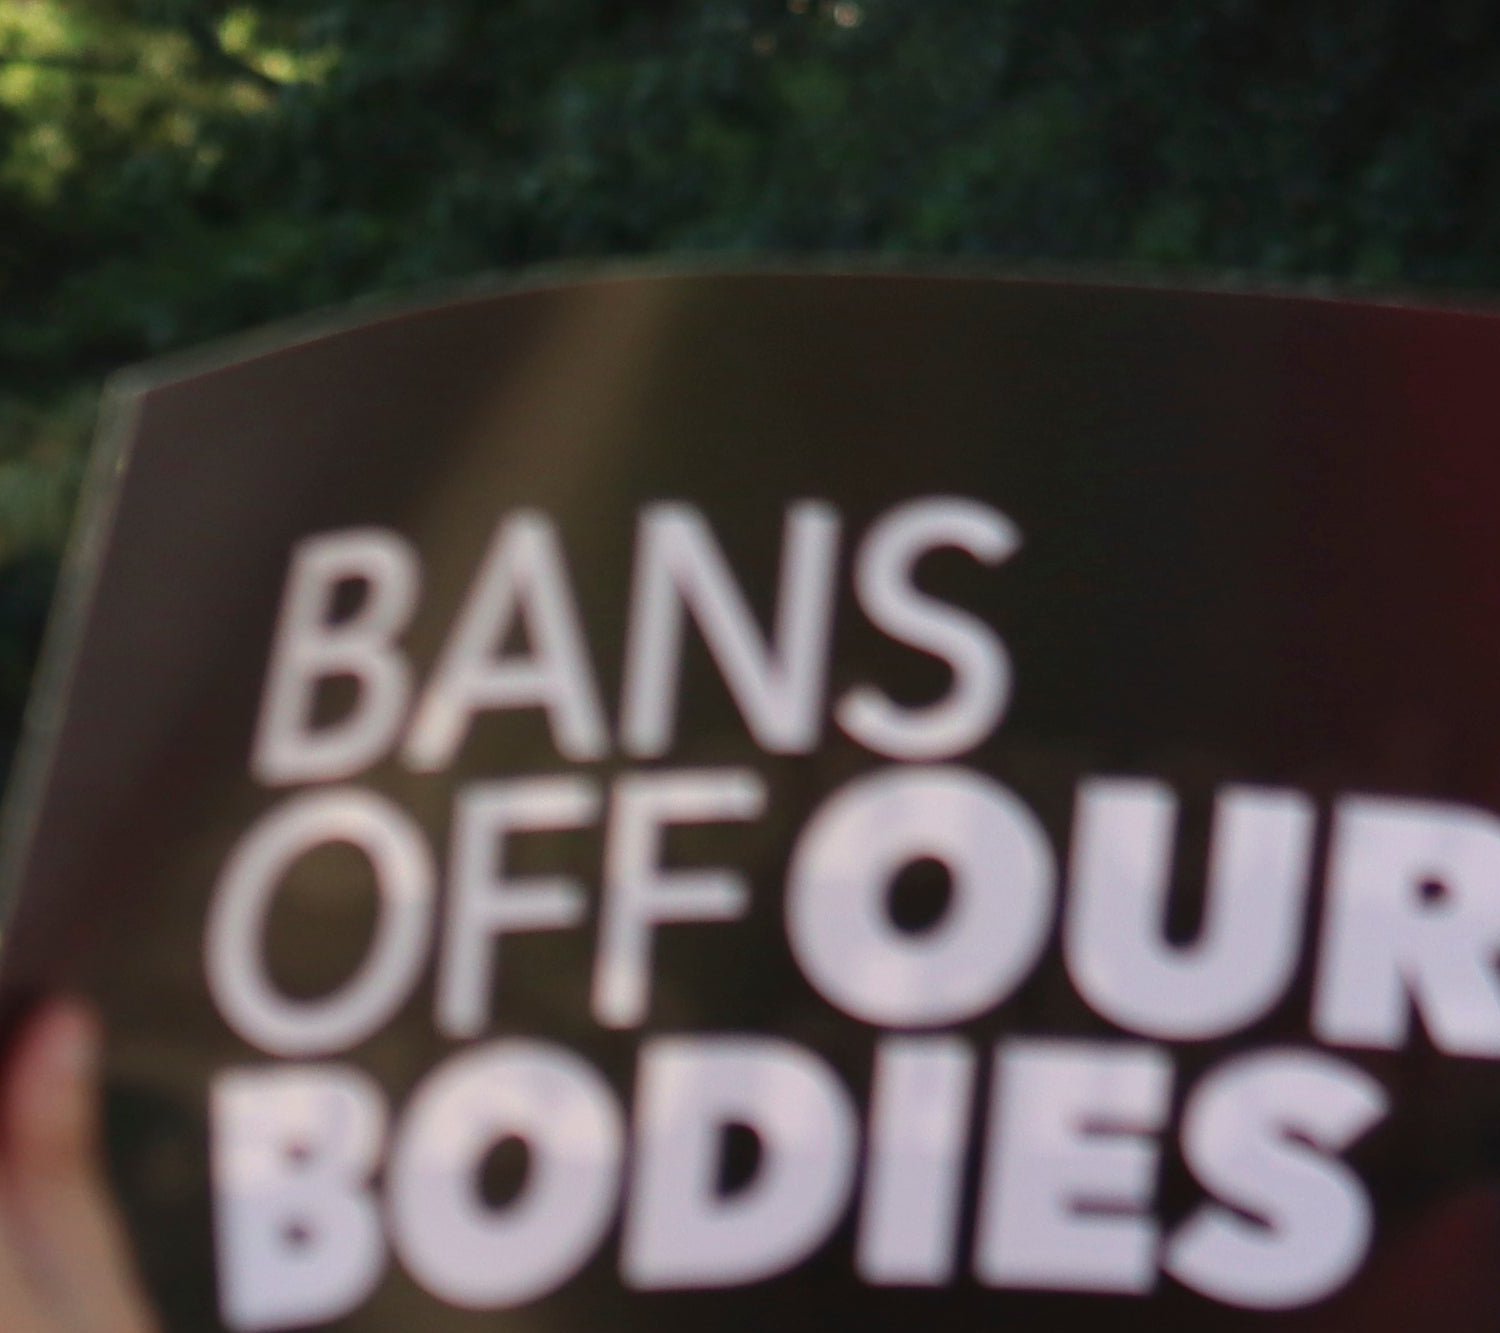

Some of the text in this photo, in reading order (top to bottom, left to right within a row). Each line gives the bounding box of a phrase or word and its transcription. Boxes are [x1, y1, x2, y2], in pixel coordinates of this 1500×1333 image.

[253, 498, 1019, 786] BANS
[205, 770, 766, 1058] OFF
[208, 1036, 1386, 1332] BODIES
